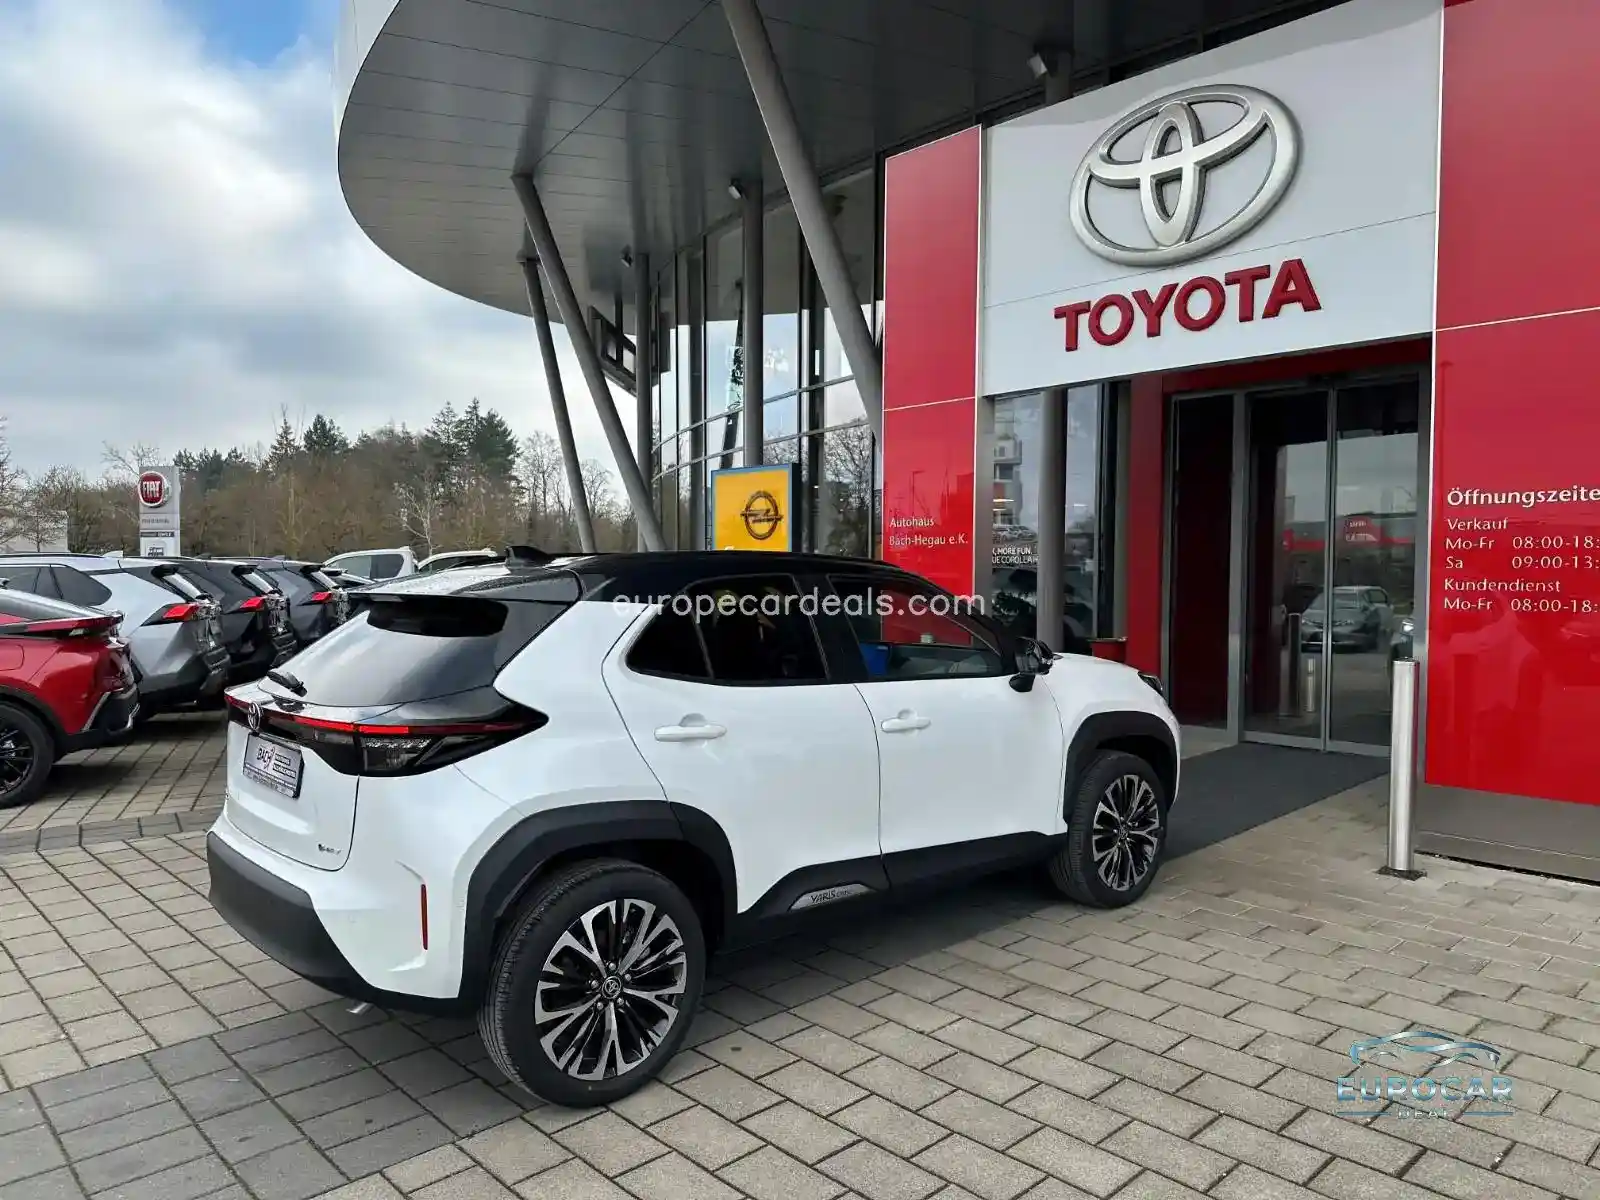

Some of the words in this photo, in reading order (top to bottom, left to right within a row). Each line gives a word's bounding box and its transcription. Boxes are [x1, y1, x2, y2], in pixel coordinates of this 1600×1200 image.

[1054, 258, 1322, 352] TOYOTA
[142, 480, 161, 498] FIAT
[1447, 485, 1600, 508] Öffnungszeite
[889, 517, 935, 528] Autohaus
[1447, 517, 1509, 531] Verkauf
[889, 535, 946, 549] Bach-Hegau
[948, 533, 969, 545] e.K.
[1445, 537, 1495, 550] Mo-Fr
[1445, 556, 1464, 569] Sa
[1444, 578, 1561, 592] Kundendienst
[1444, 597, 1493, 611] Mo-Fr
[811, 890, 836, 904] YARIS
